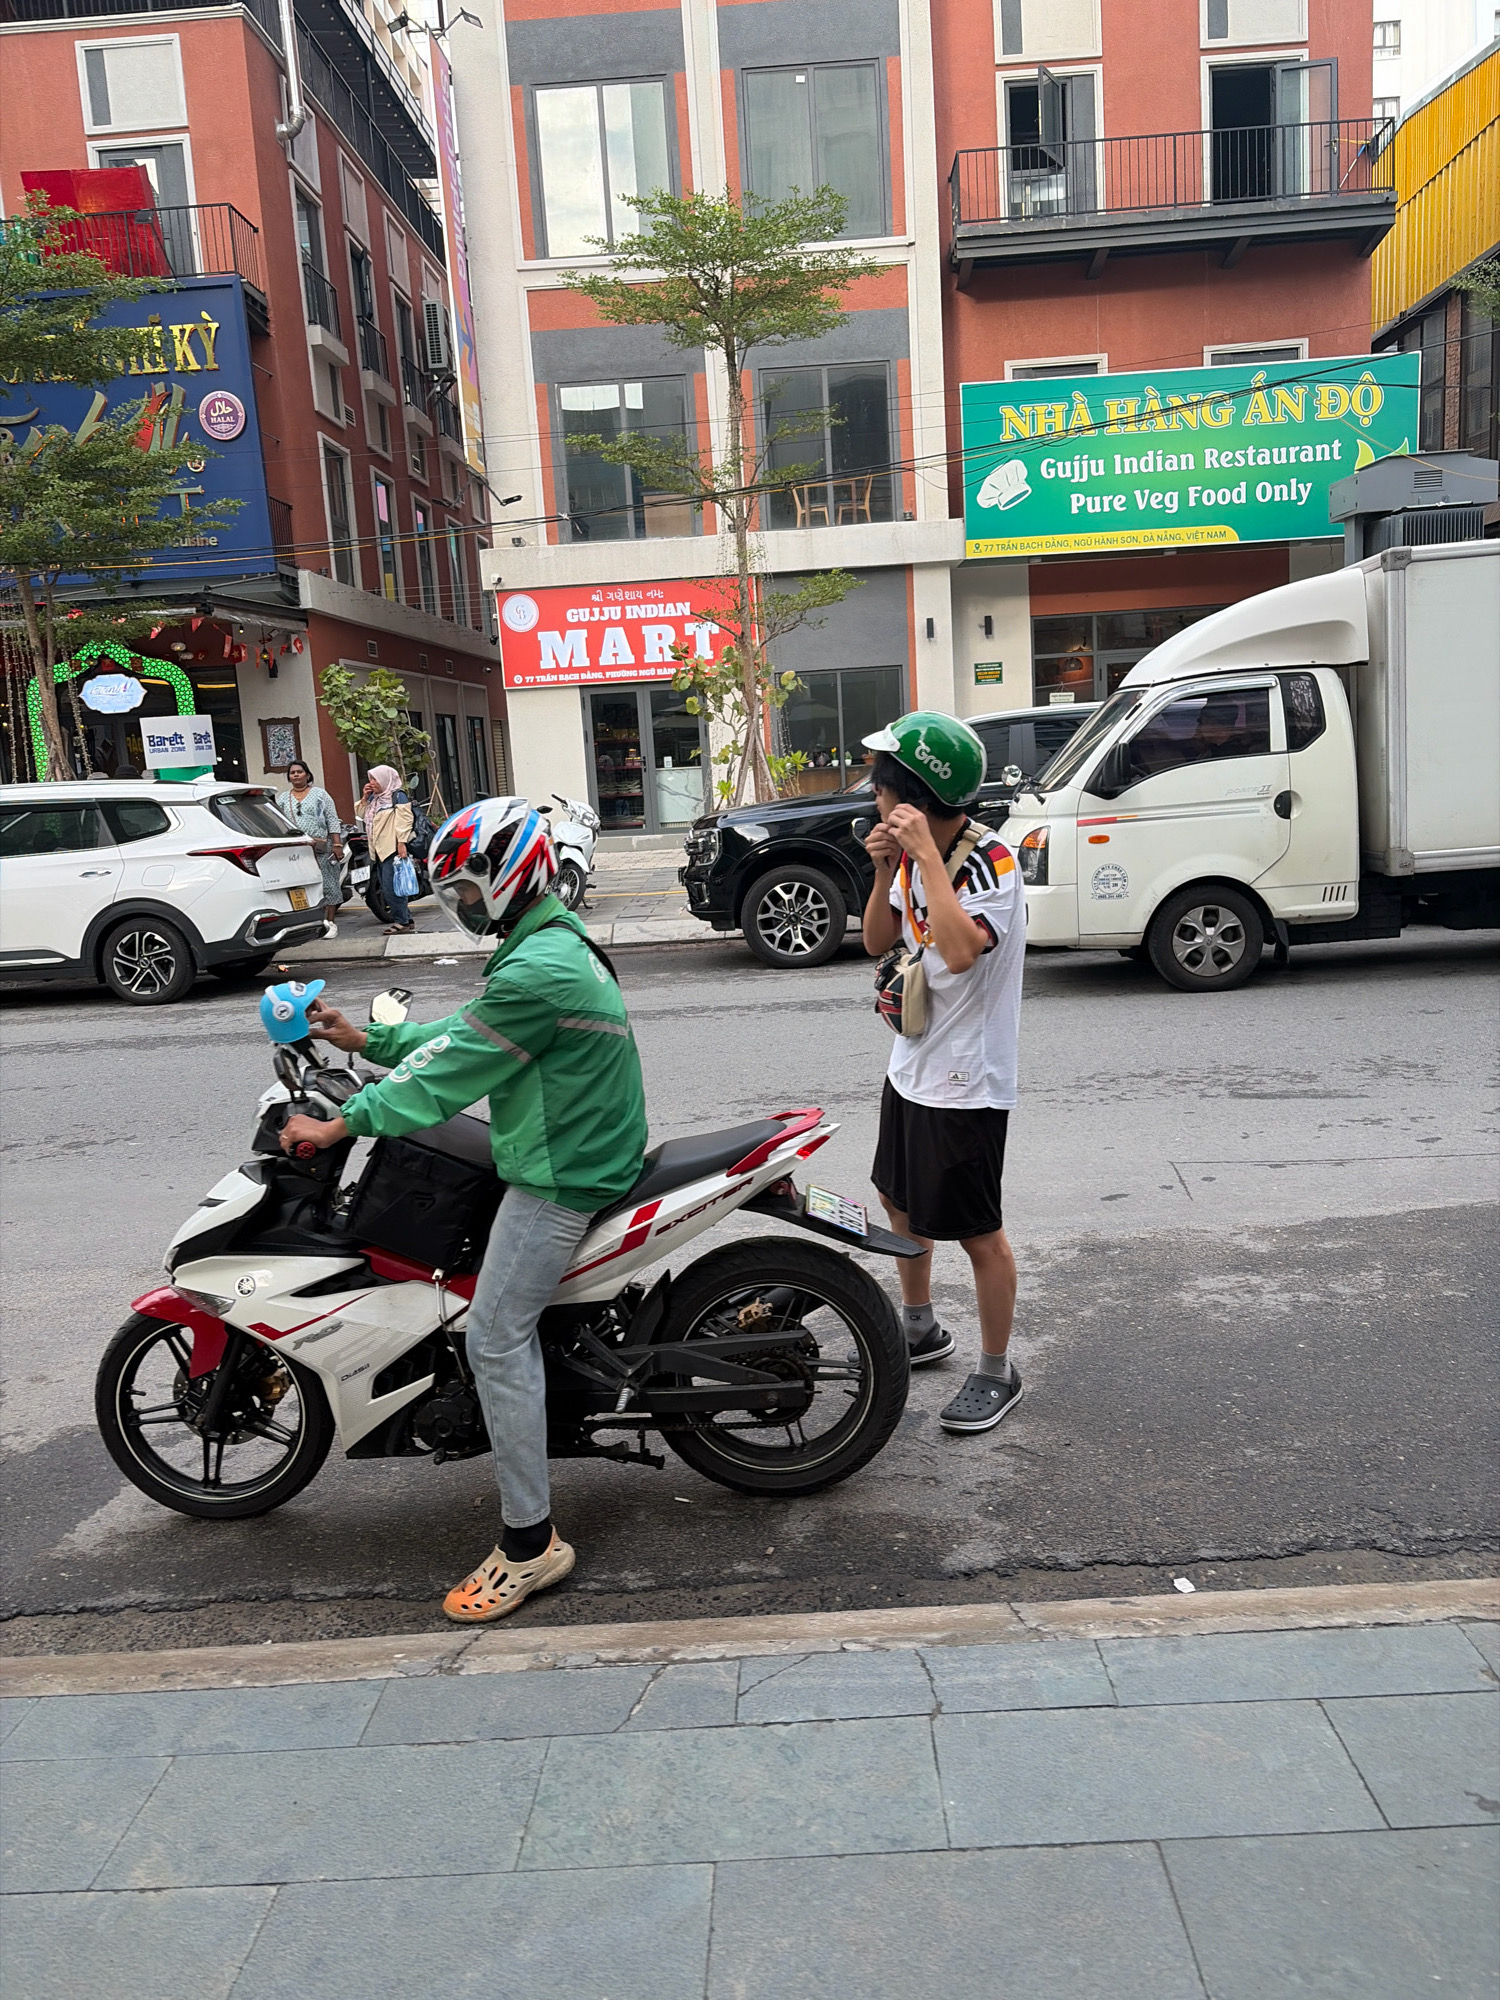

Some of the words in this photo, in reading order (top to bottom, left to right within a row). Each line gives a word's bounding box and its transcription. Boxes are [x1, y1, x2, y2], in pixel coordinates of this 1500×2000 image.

[441, 68, 467, 281] SHOPPING
[168, 310, 219, 371] KỲ
[210, 400, 233, 416] حلال
[1000, 391, 1097, 441] NHÀ
[1104, 386, 1235, 435] HÀNG
[1314, 371, 1384, 427] ĐỘ
[1040, 454, 1105, 483] Gujju
[1114, 450, 1195, 475] Indian
[1204, 439, 1342, 469] Restaurant
[1070, 493, 1126, 514] Pure
[1134, 488, 1179, 513] Veg
[1188, 481, 1246, 506] Food
[1255, 478, 1312, 505] Only
[984, 544, 994, 552] 77
[1020, 541, 1043, 552] BẠCH
[1074, 537, 1093, 547] NGŨ
[1094, 535, 1119, 546] HÀNH
[1143, 533, 1155, 543] ĐÀ
[1186, 530, 1205, 541] VIỆT
[1206, 531, 1227, 539] NAM
[566, 606, 621, 622] GUJJU
[625, 602, 691, 619] INDIAN
[591, 590, 603, 602] શ્રી
[537, 621, 719, 669] MART
[525, 675, 534, 683] 77
[559, 673, 580, 683] BẠCH
[146, 731, 185, 747] Barett
[192, 730, 212, 744] Barett
[914, 742, 952, 780] Grab
[654, 1176, 754, 1237] EXCITER
